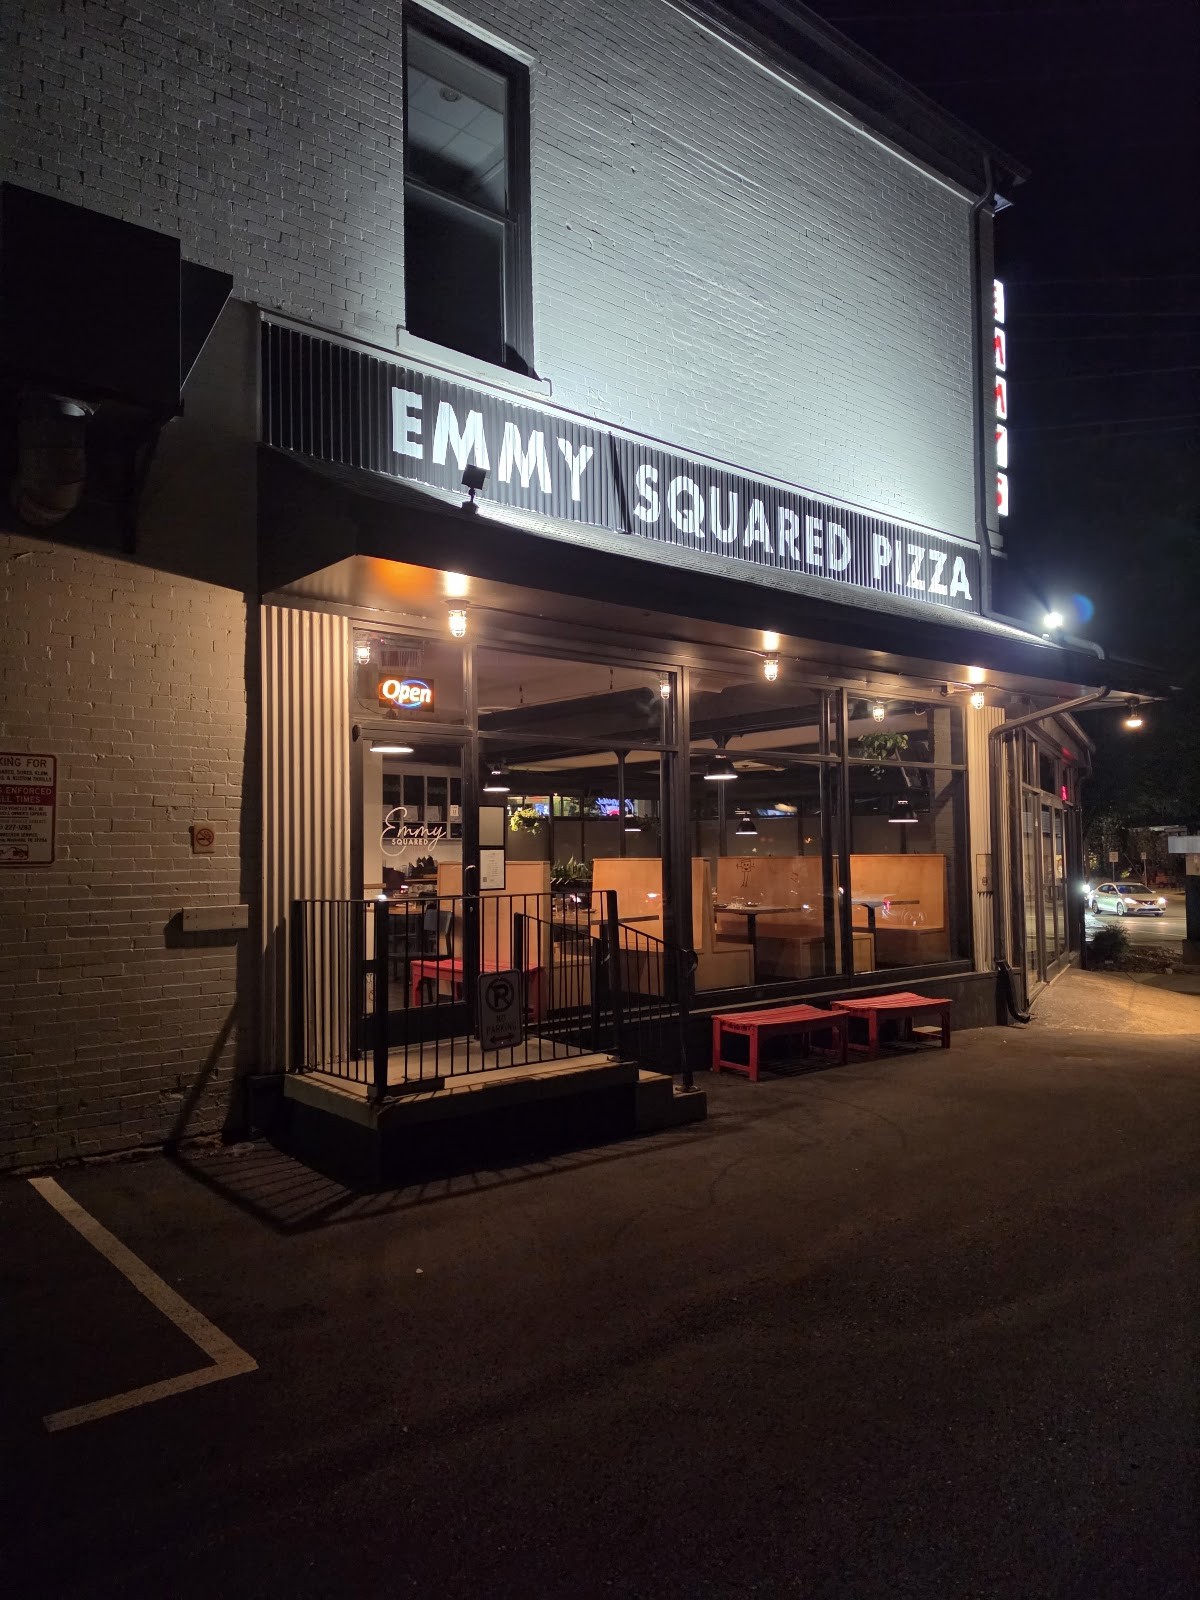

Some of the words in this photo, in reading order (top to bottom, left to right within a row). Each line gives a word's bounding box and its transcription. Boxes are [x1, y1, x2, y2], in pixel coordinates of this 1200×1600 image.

[391, 386, 594, 502] EMMY
[633, 464, 852, 574] SQUARED
[872, 532, 973, 601] PIZZA
[382, 679, 432, 704] Open
[26, 758, 47, 768] FOR
[6, 786, 52, 795] ENFORCED
[15, 795, 41, 803] TIMES
[379, 806, 447, 857] Emmy
[391, 838, 429, 846] SQUARED
